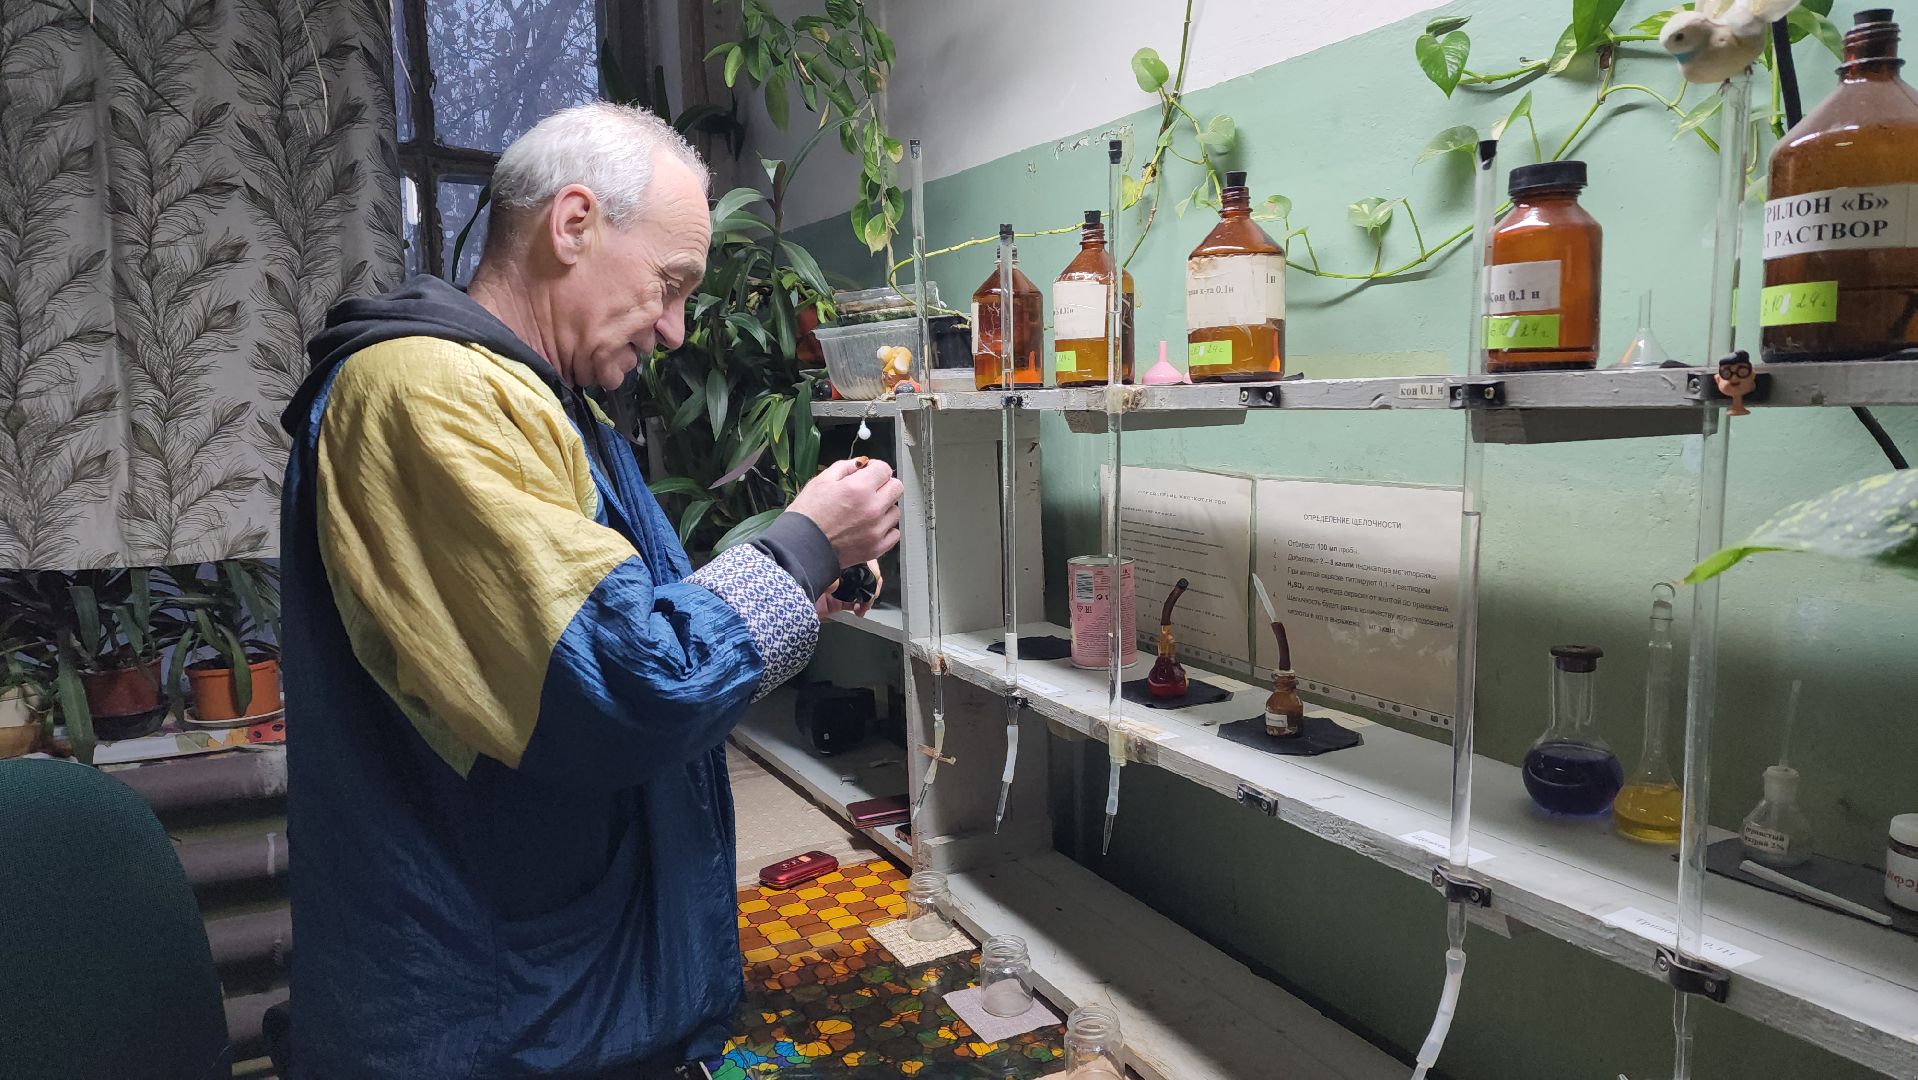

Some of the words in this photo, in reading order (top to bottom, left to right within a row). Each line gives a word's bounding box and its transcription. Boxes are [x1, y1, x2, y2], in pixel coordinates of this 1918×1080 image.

[1841, 192, 1888, 211] «Б»
[1774, 219, 1889, 246] РАСТВОР
[1303, 513, 1351, 526] ОПРЕДЕЛЕНИЕ
[1352, 518, 1402, 530] ЩЕЛОЧНОСТИ
